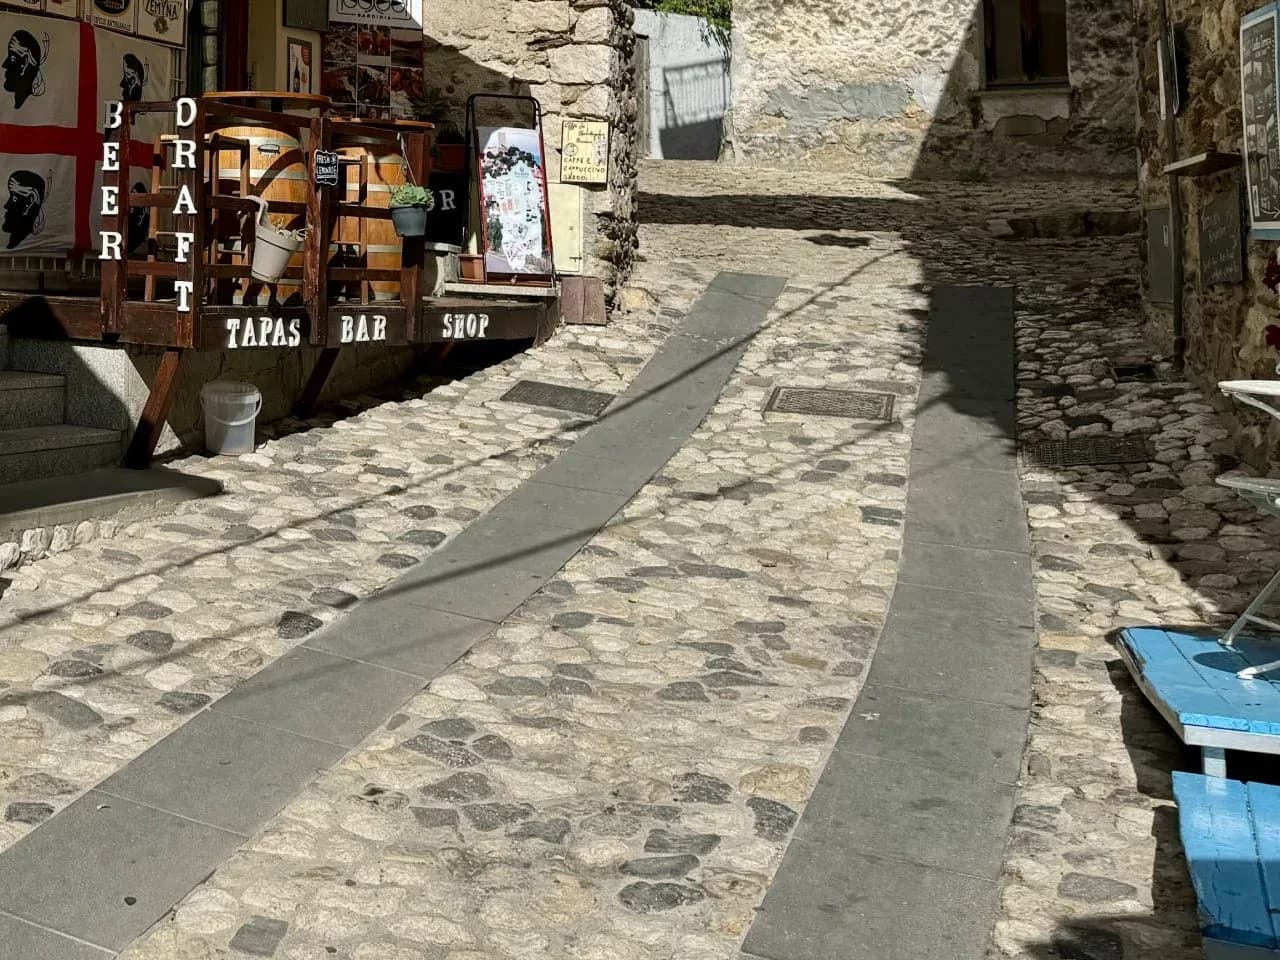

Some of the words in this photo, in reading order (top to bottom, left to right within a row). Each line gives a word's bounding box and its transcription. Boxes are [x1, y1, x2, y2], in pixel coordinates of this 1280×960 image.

[98, 100, 123, 261] BEER
[171, 97, 198, 313] DRAFT
[226, 316, 302, 349] TAPAS
[341, 314, 387, 344] BAR
[442, 313, 490, 340] SHOP
